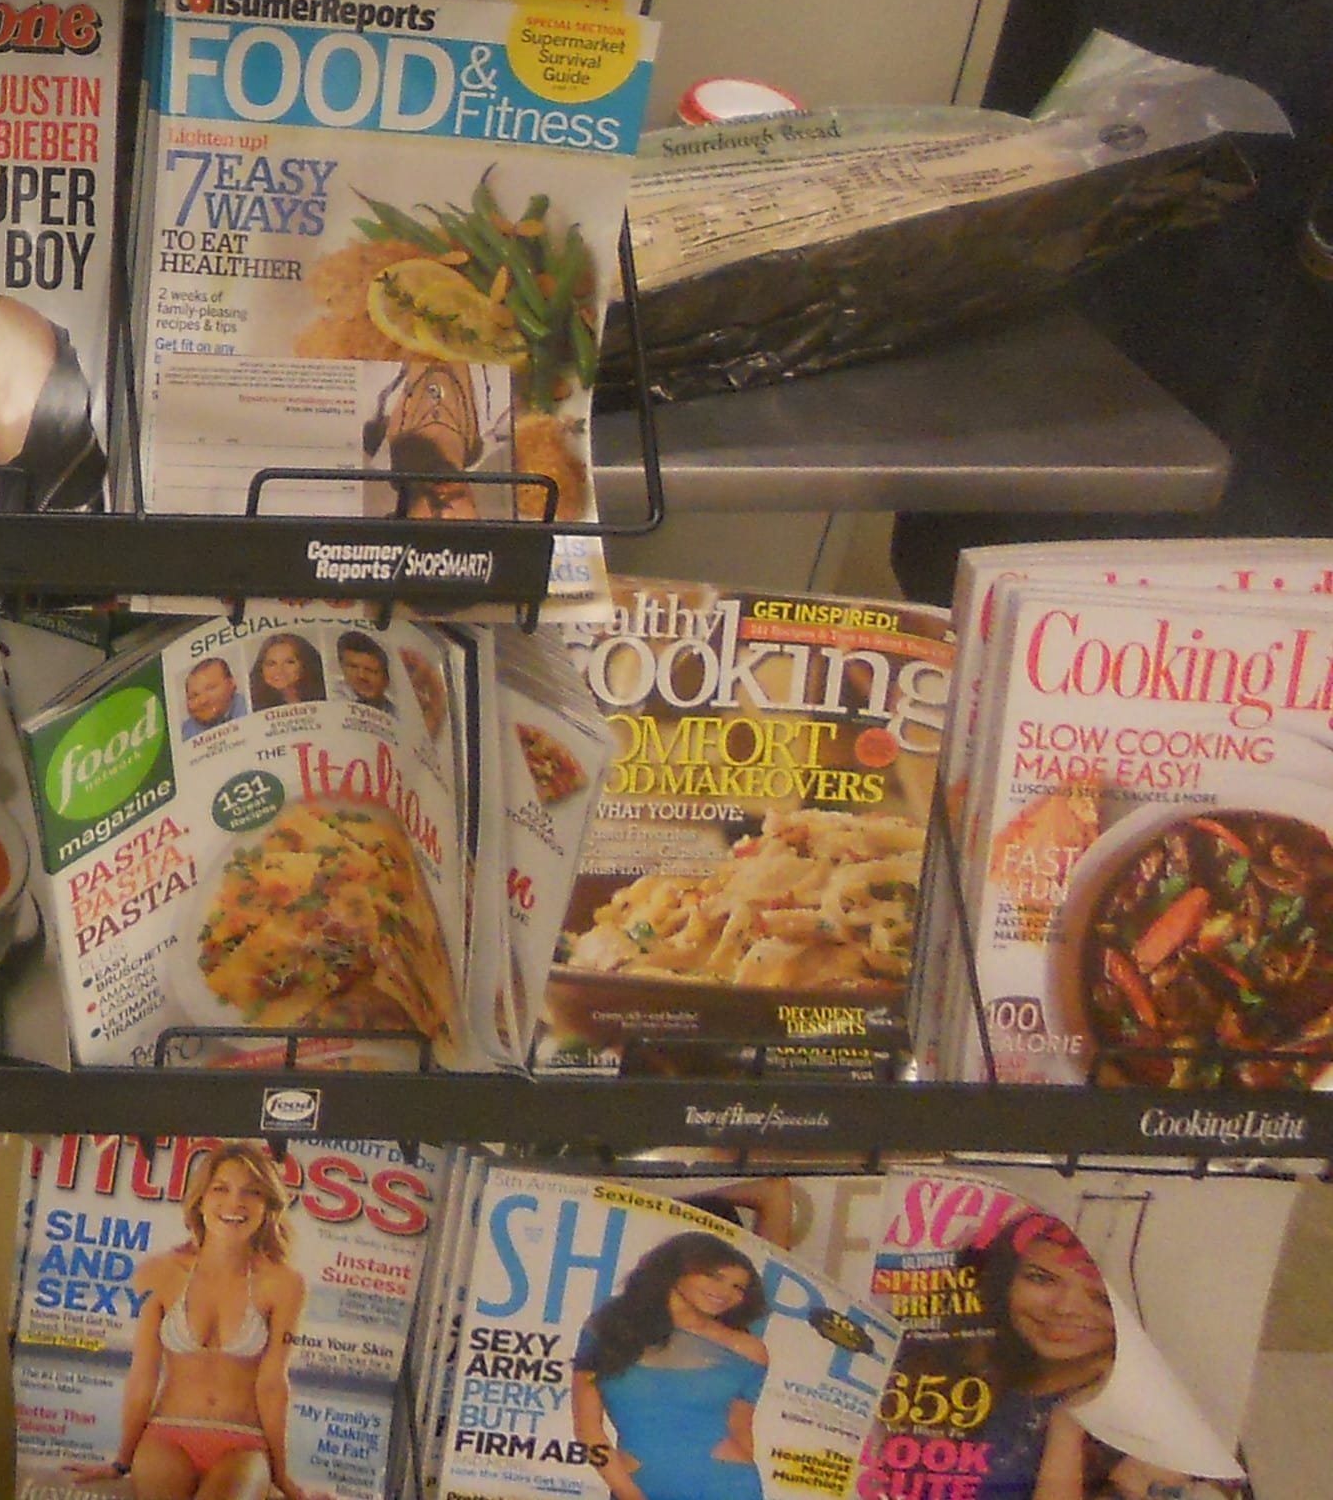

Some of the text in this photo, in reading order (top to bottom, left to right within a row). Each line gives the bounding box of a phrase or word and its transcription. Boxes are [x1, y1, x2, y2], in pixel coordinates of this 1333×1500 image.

[521, 28, 625, 55] Supermarket
[537, 50, 601, 69] Survival
[170, 20, 497, 132] FOOD &
[543, 67, 589, 86] Guide
[453, 90, 620, 150] Fitness
[166, 150, 337, 226] 7 EASY
[203, 193, 325, 236] WAYS
[5, 231, 95, 290] BOY
[162, 229, 248, 254] TO EAT
[160, 254, 301, 281] HEALTHIER
[753, 601, 899, 632] GET INSPIRED!
[1028, 611, 1283, 730] Cooking
[1017, 721, 1275, 763] SLOW COOKING
[660, 765, 884, 802] MAKEOVERS
[1015, 753, 1199, 788] MADE EASY!
[217, 769, 271, 812] 131
[57, 779, 173, 861] magazine
[75, 863, 198, 957] PASTA!
[1141, 1107, 1304, 1141] Cooking Light
[45, 1210, 151, 1251] SLIM
[38, 1245, 132, 1282] AND
[35, 1279, 153, 1318] SEXY
[469, 1329, 561, 1356] SEXY
[465, 1356, 564, 1384] ARMS
[874, 1372, 992, 1427] 659
[455, 1429, 609, 1467] FIRM ABS
